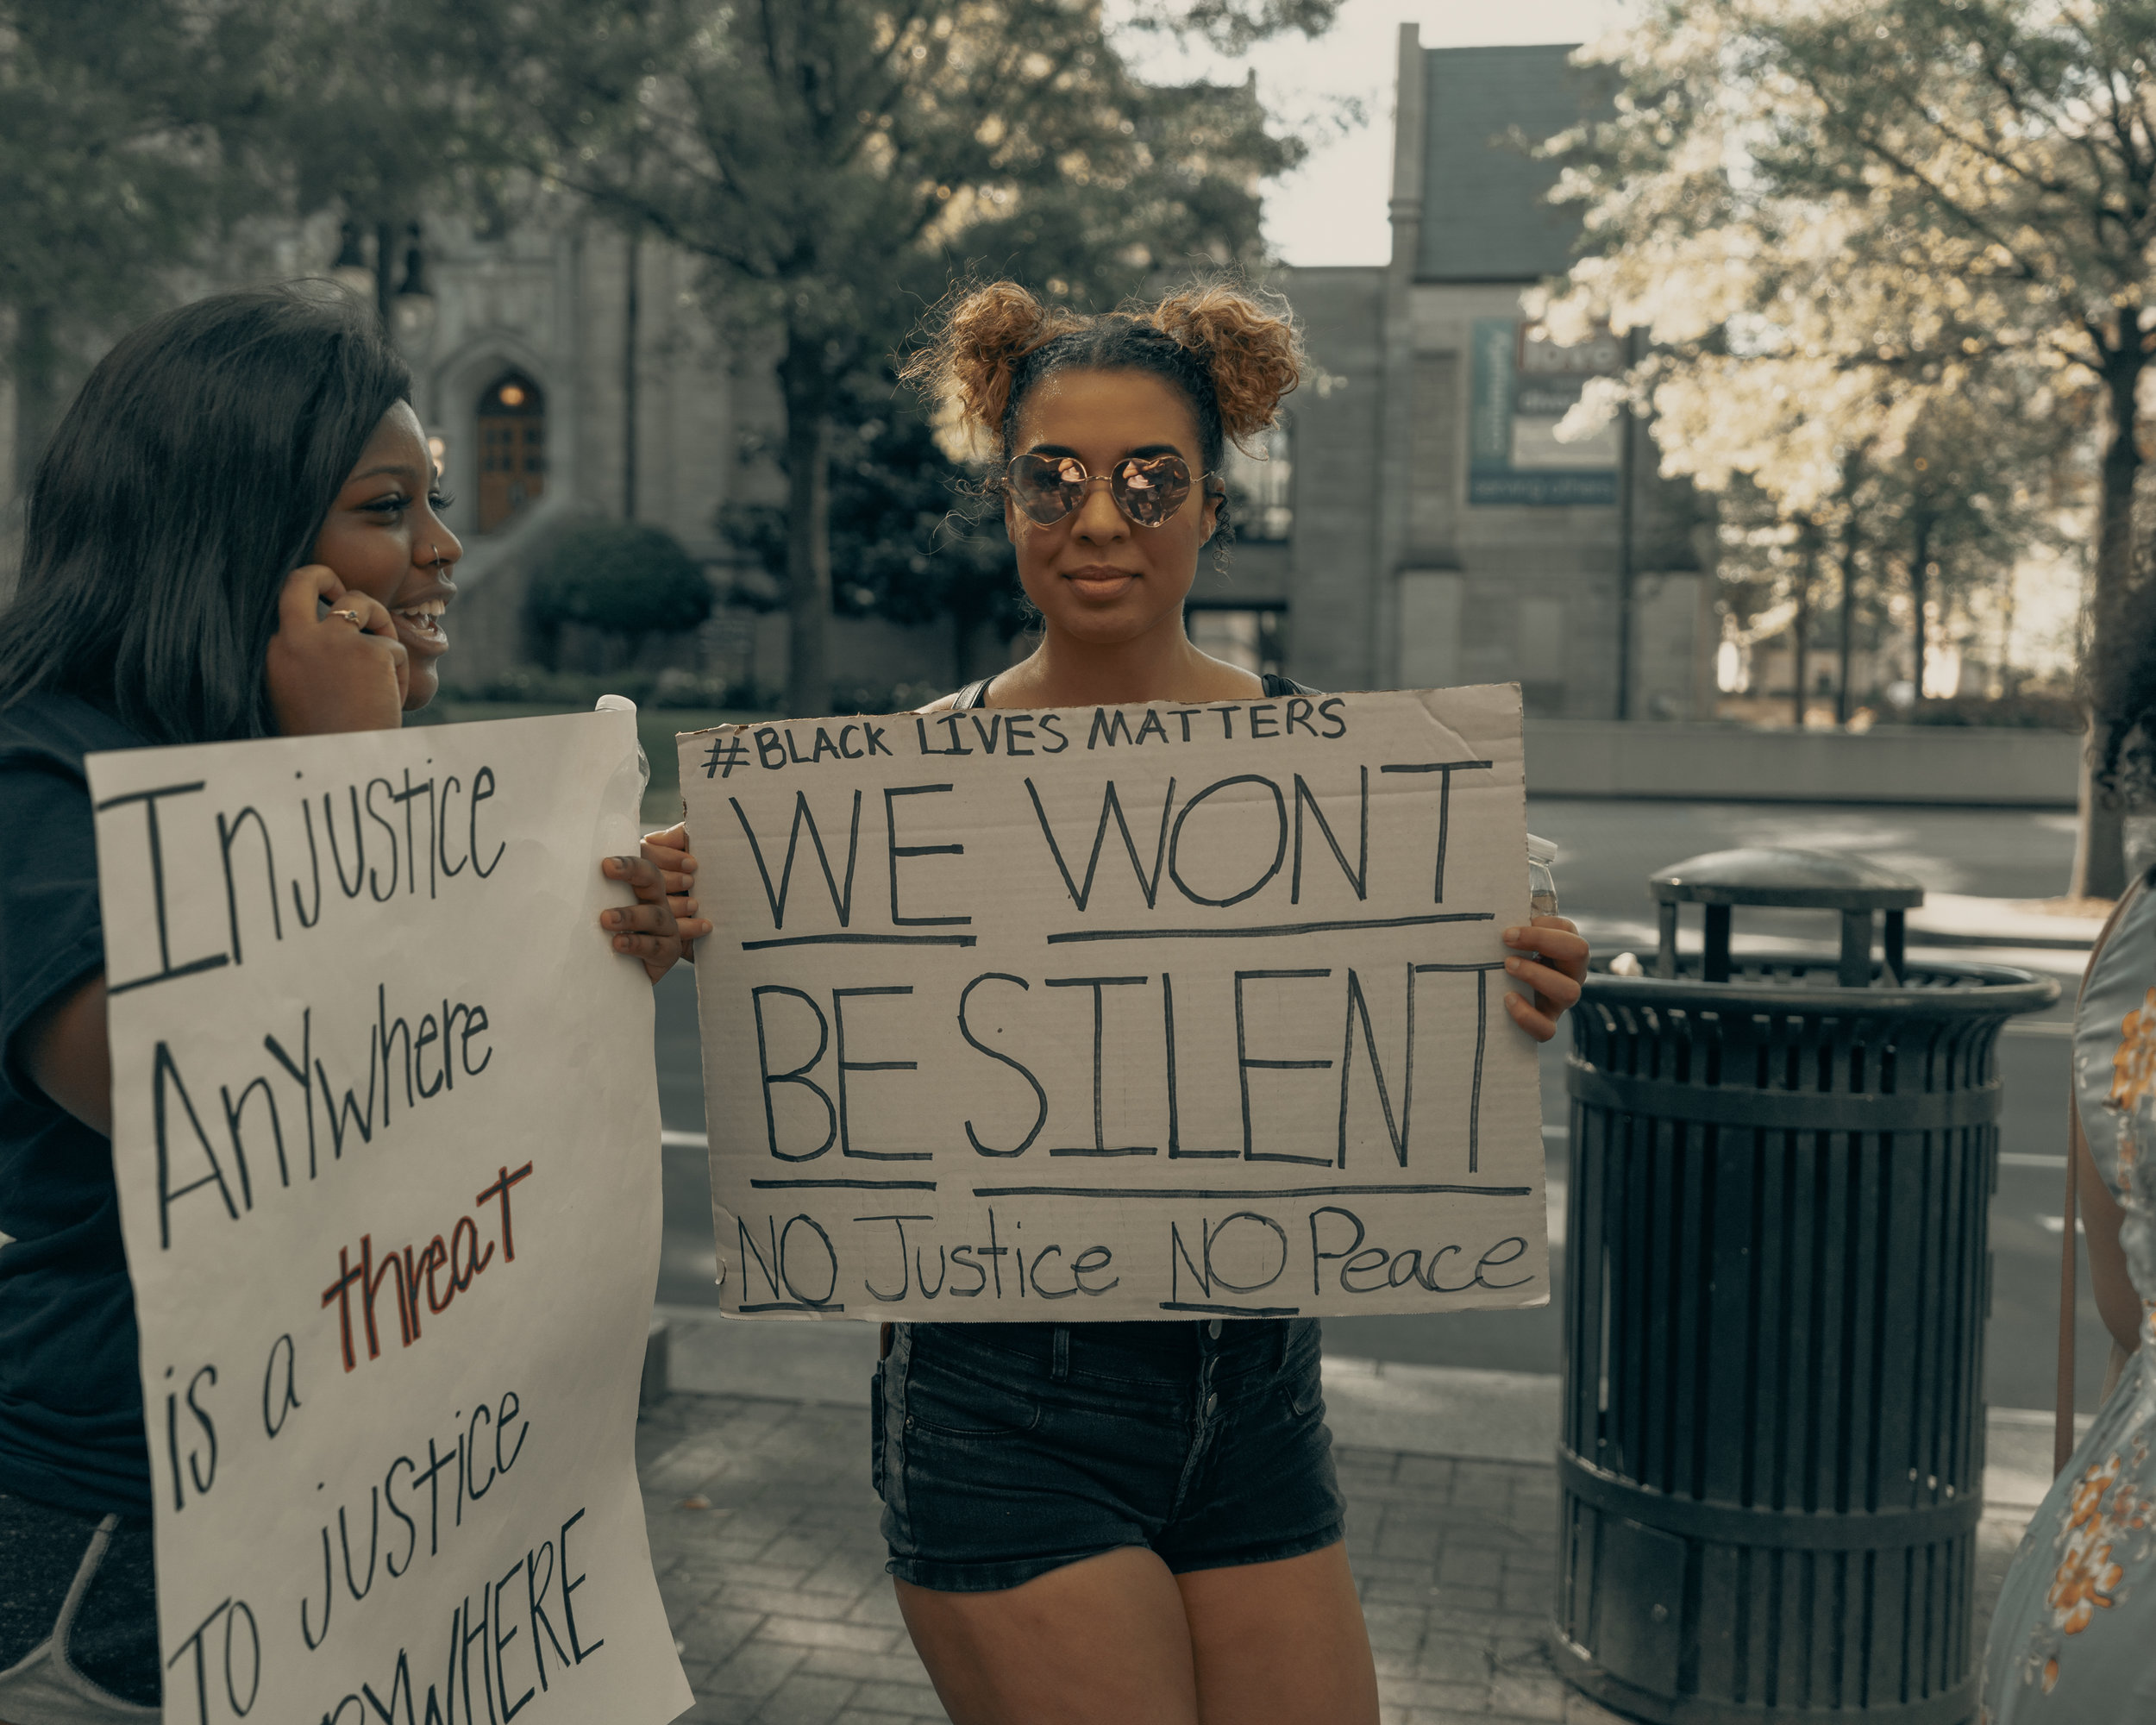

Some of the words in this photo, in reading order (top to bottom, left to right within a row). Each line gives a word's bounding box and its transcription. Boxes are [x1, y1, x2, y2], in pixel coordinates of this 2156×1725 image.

[700, 722, 893, 779] #BLACK
[916, 712, 1069, 756] LIVES
[1087, 697, 1348, 750] MATTERS
[95, 759, 506, 996] Injustice
[728, 783, 972, 930] WE
[1024, 760, 1494, 912] WONT
[751, 984, 933, 1163] BE
[957, 962, 1507, 1174] SILENT
[737, 1213, 837, 1305] NO
[853, 1206, 1119, 1302] Justice
[1171, 1211, 1288, 1303] NO
[1309, 1206, 1535, 1295] Peace
[264, 1333, 302, 1440] a
